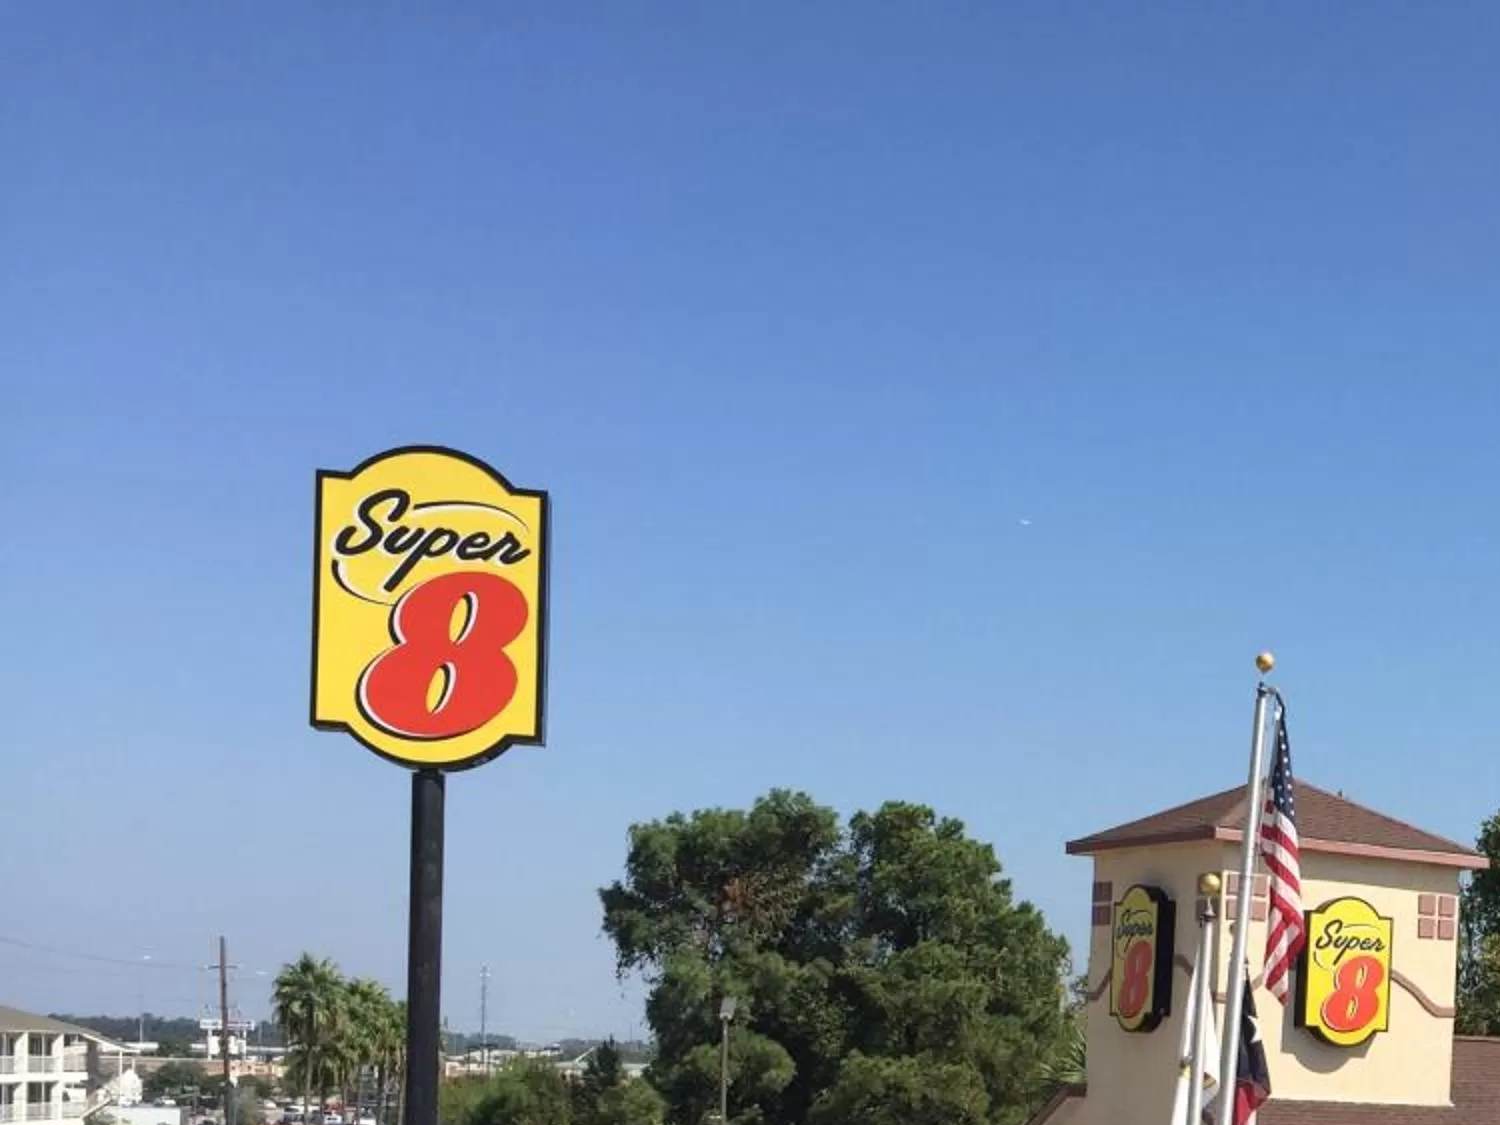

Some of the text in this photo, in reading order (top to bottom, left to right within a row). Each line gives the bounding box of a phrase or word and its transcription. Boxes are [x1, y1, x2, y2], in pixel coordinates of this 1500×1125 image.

[335, 488, 531, 592] Super
[355, 571, 529, 741] 8
[1118, 940, 1153, 1019] 8
[1315, 918, 1385, 965] Super
[1320, 954, 1385, 1033] 8
